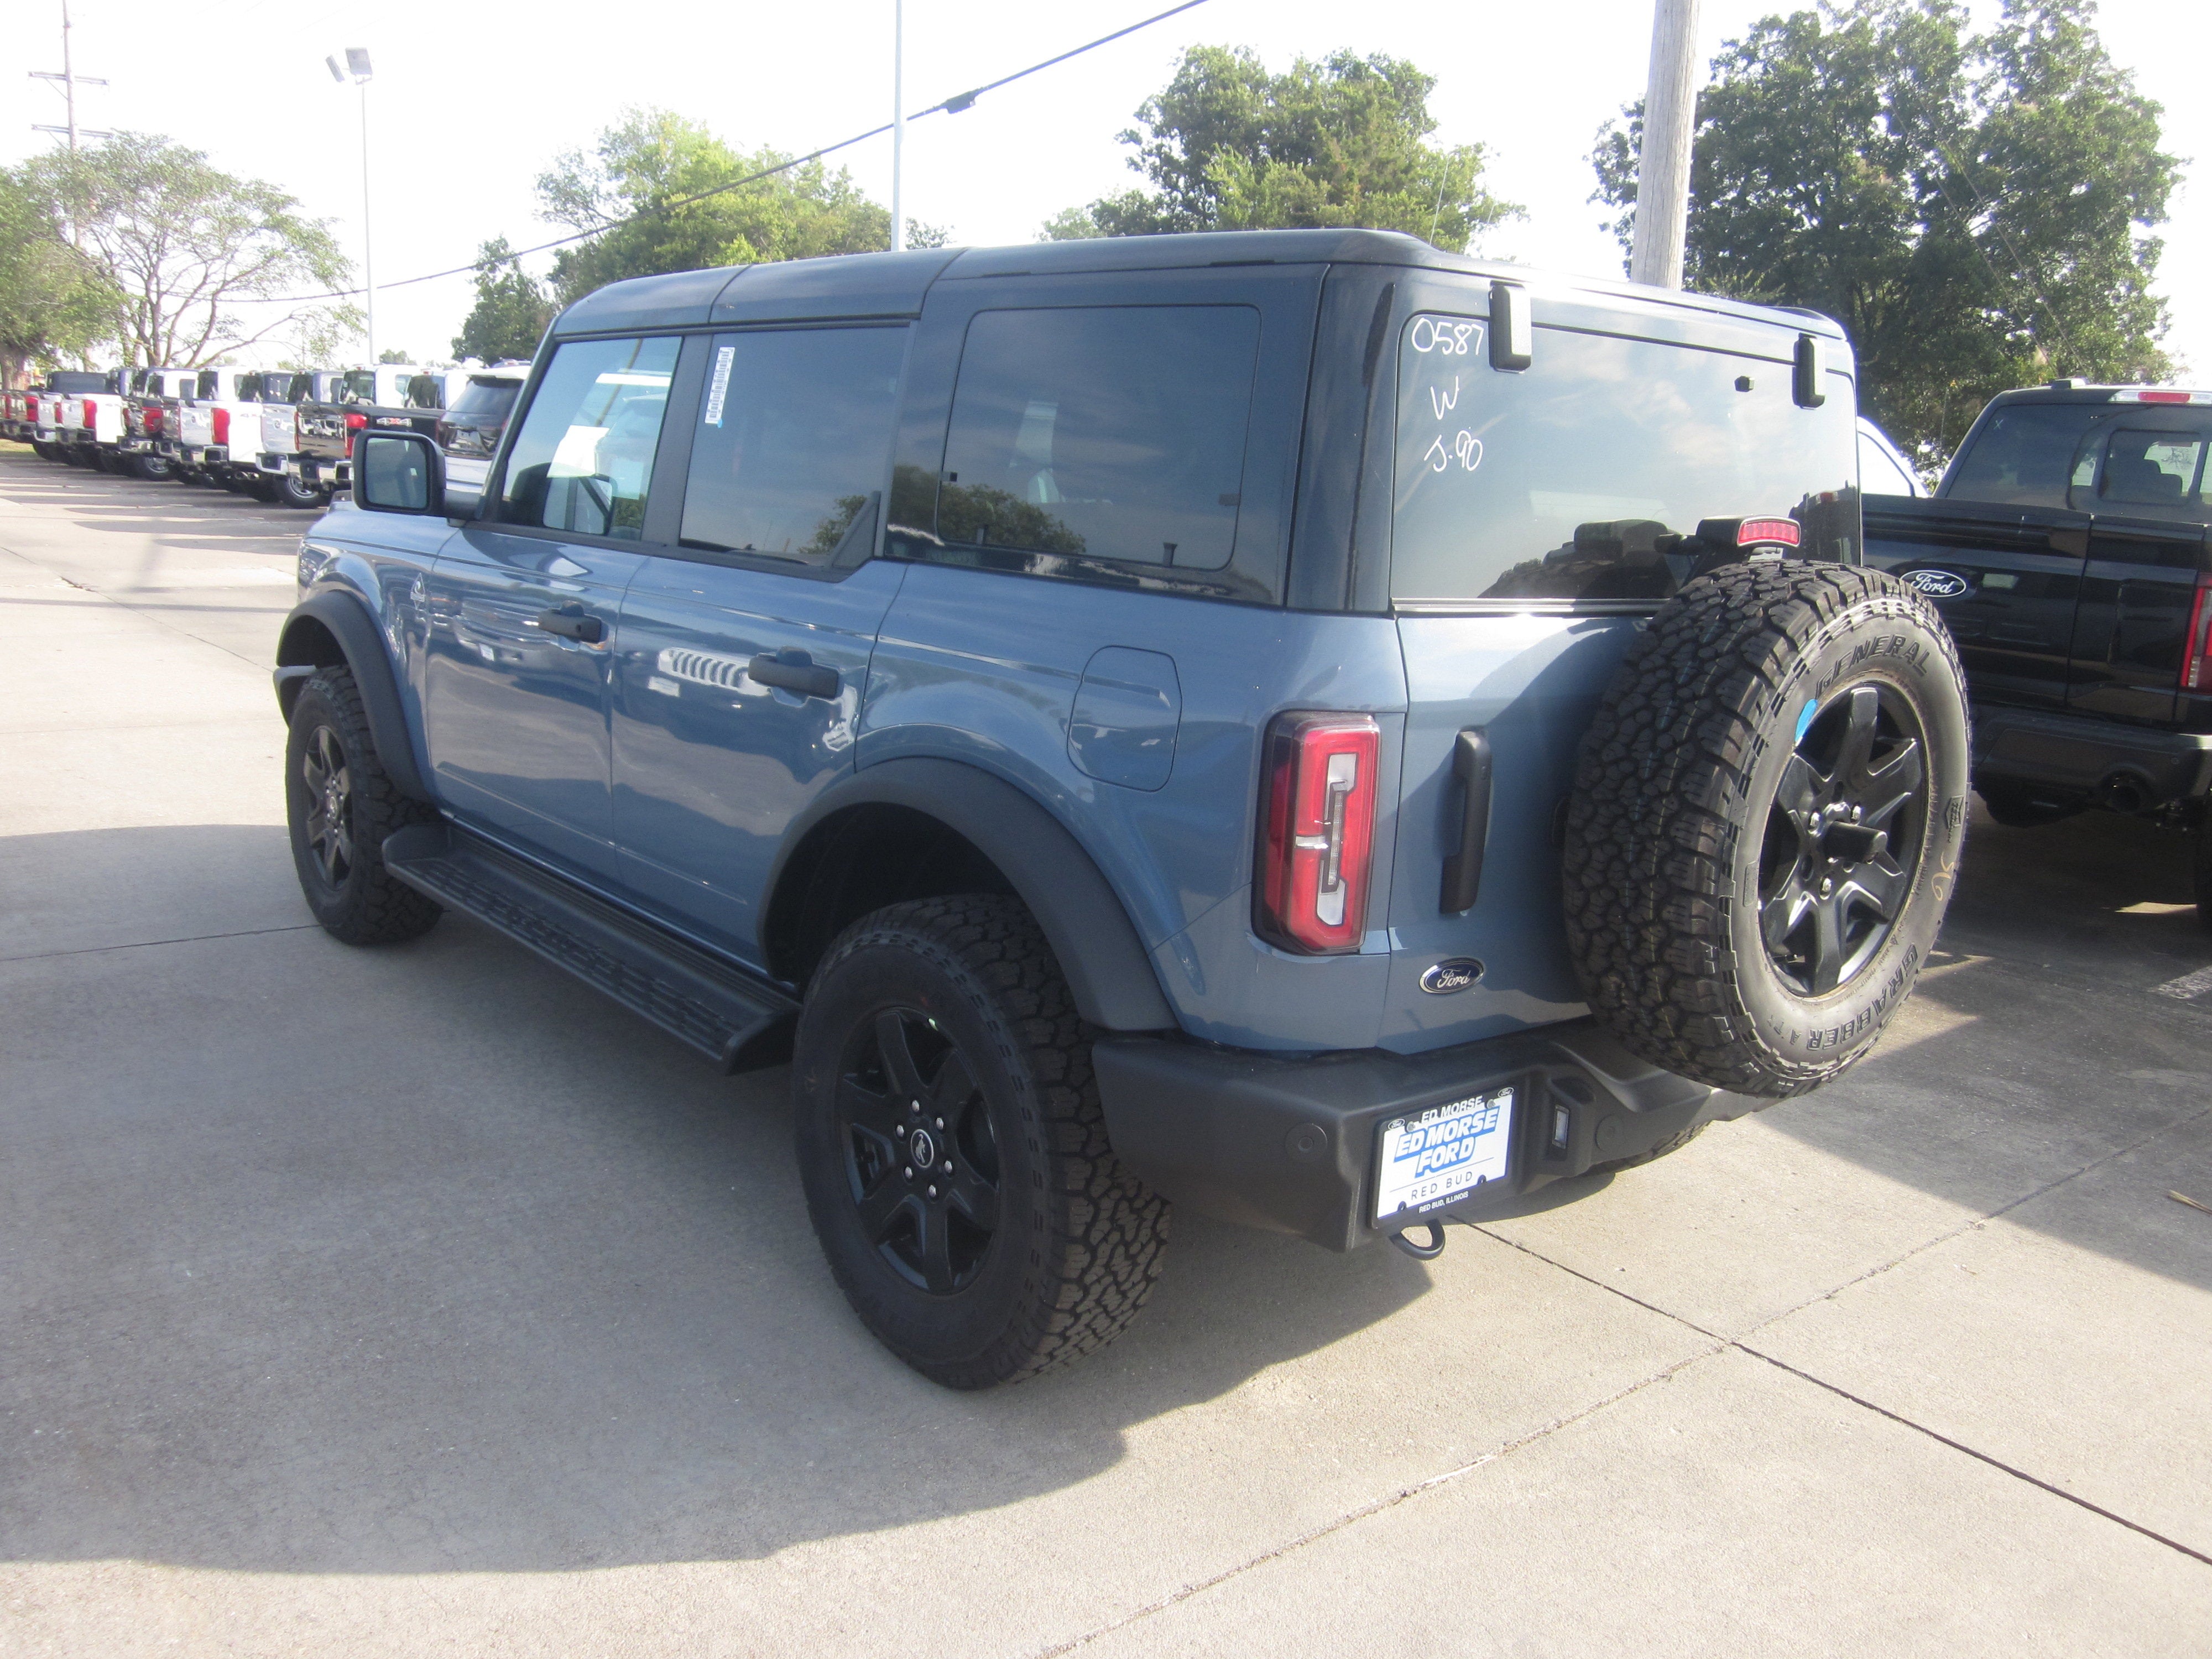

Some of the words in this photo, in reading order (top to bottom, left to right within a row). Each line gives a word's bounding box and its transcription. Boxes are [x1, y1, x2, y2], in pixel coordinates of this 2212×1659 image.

[1411, 317, 1484, 356] 0587
[1430, 375, 1459, 420] W
[1910, 572, 1955, 594] Ford
[1815, 634, 1930, 700] GENERAL
[1437, 968, 1471, 988] Ford
[1807, 943, 1918, 1051] GRABBER
[1421, 1109, 1438, 1122] ED
[1440, 1095, 1483, 1118] MORSE
[1395, 1130, 1425, 1159] ED
[1425, 1108, 1500, 1149] MORSE
[1415, 1136, 1475, 1175] FORD
[1411, 1183, 1438, 1201] RED
[1446, 1171, 1473, 1188] BUD
[1418, 1203, 1431, 1214] RED
[1446, 1191, 1469, 1204] ILLINOIS
